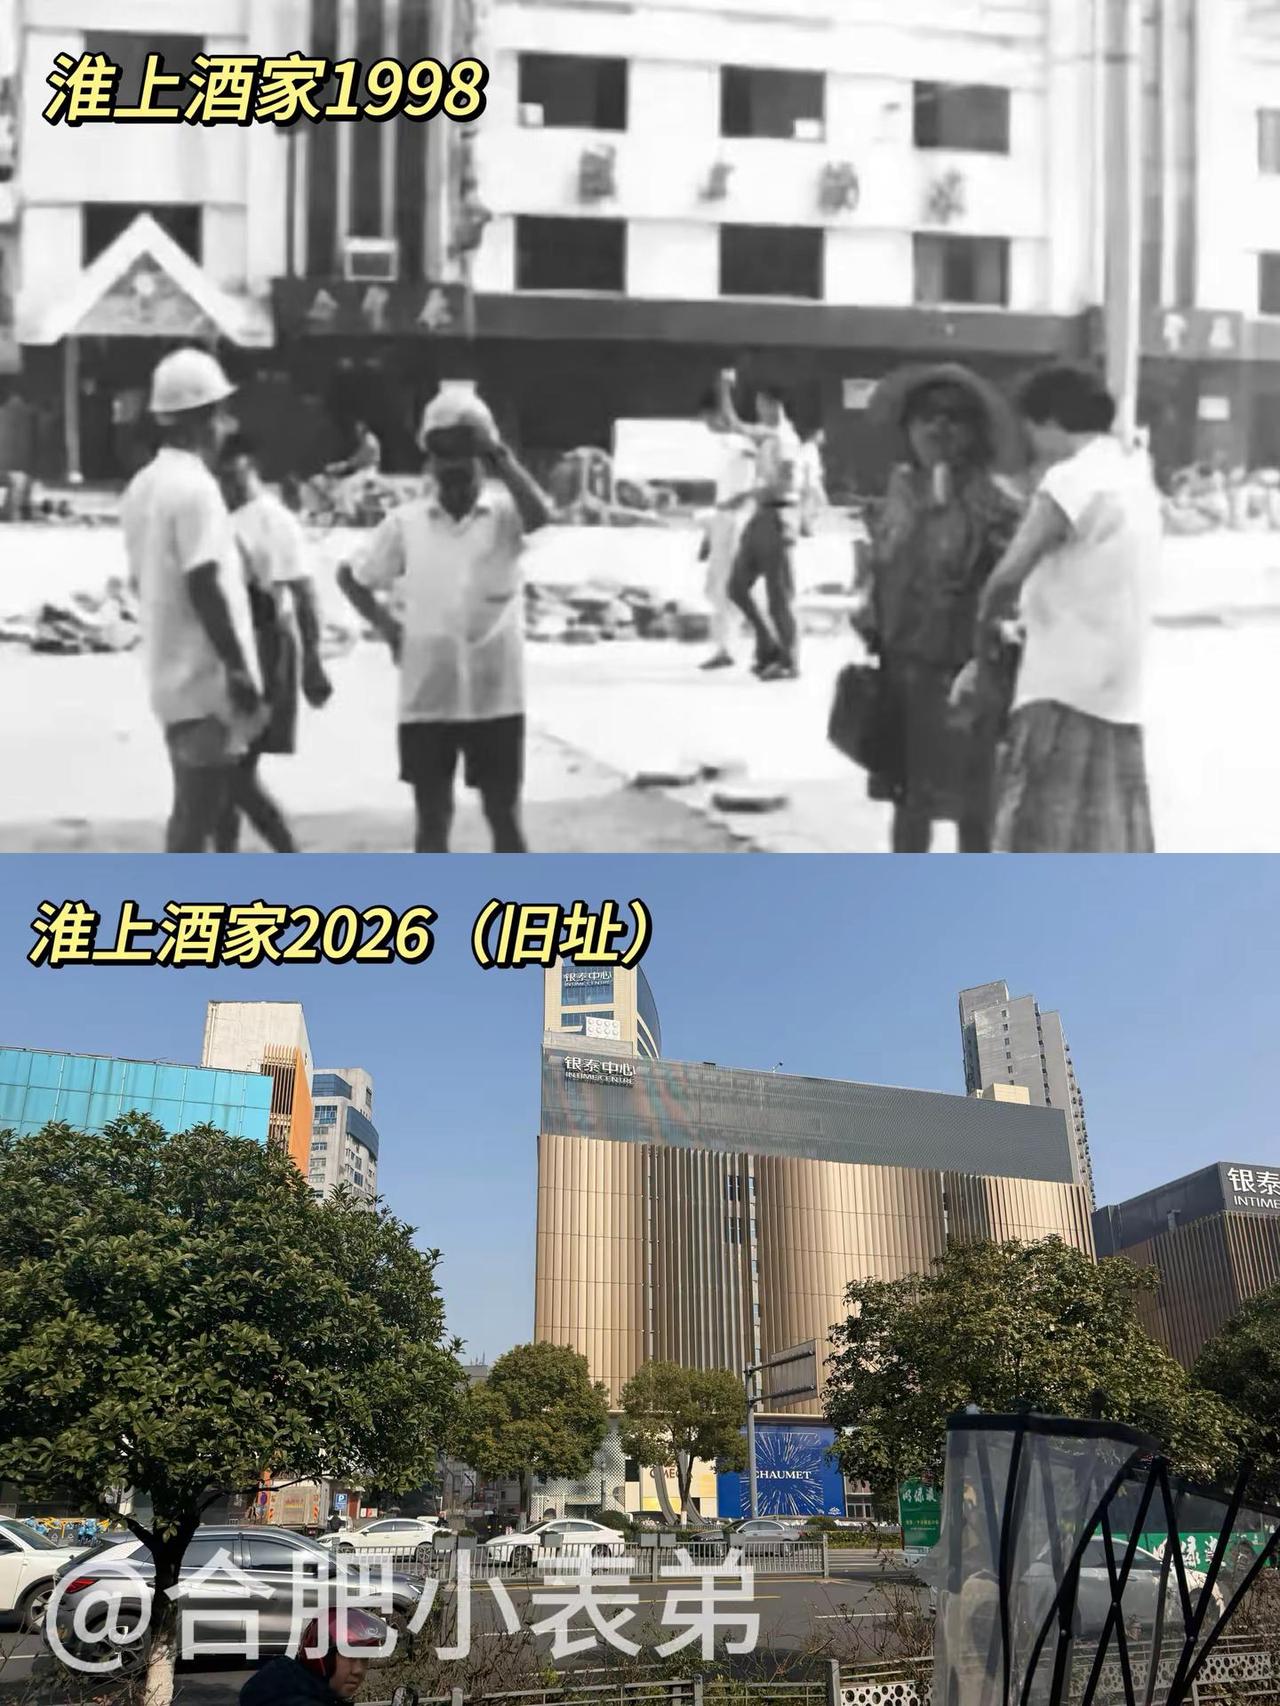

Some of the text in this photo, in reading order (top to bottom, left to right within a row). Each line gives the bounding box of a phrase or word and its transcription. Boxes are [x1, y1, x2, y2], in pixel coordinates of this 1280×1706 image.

[564, 1056, 637, 1077] 银泰中心
[1233, 1195, 1280, 1209] INTIME
[754, 1470, 812, 1480] CHAUMET
